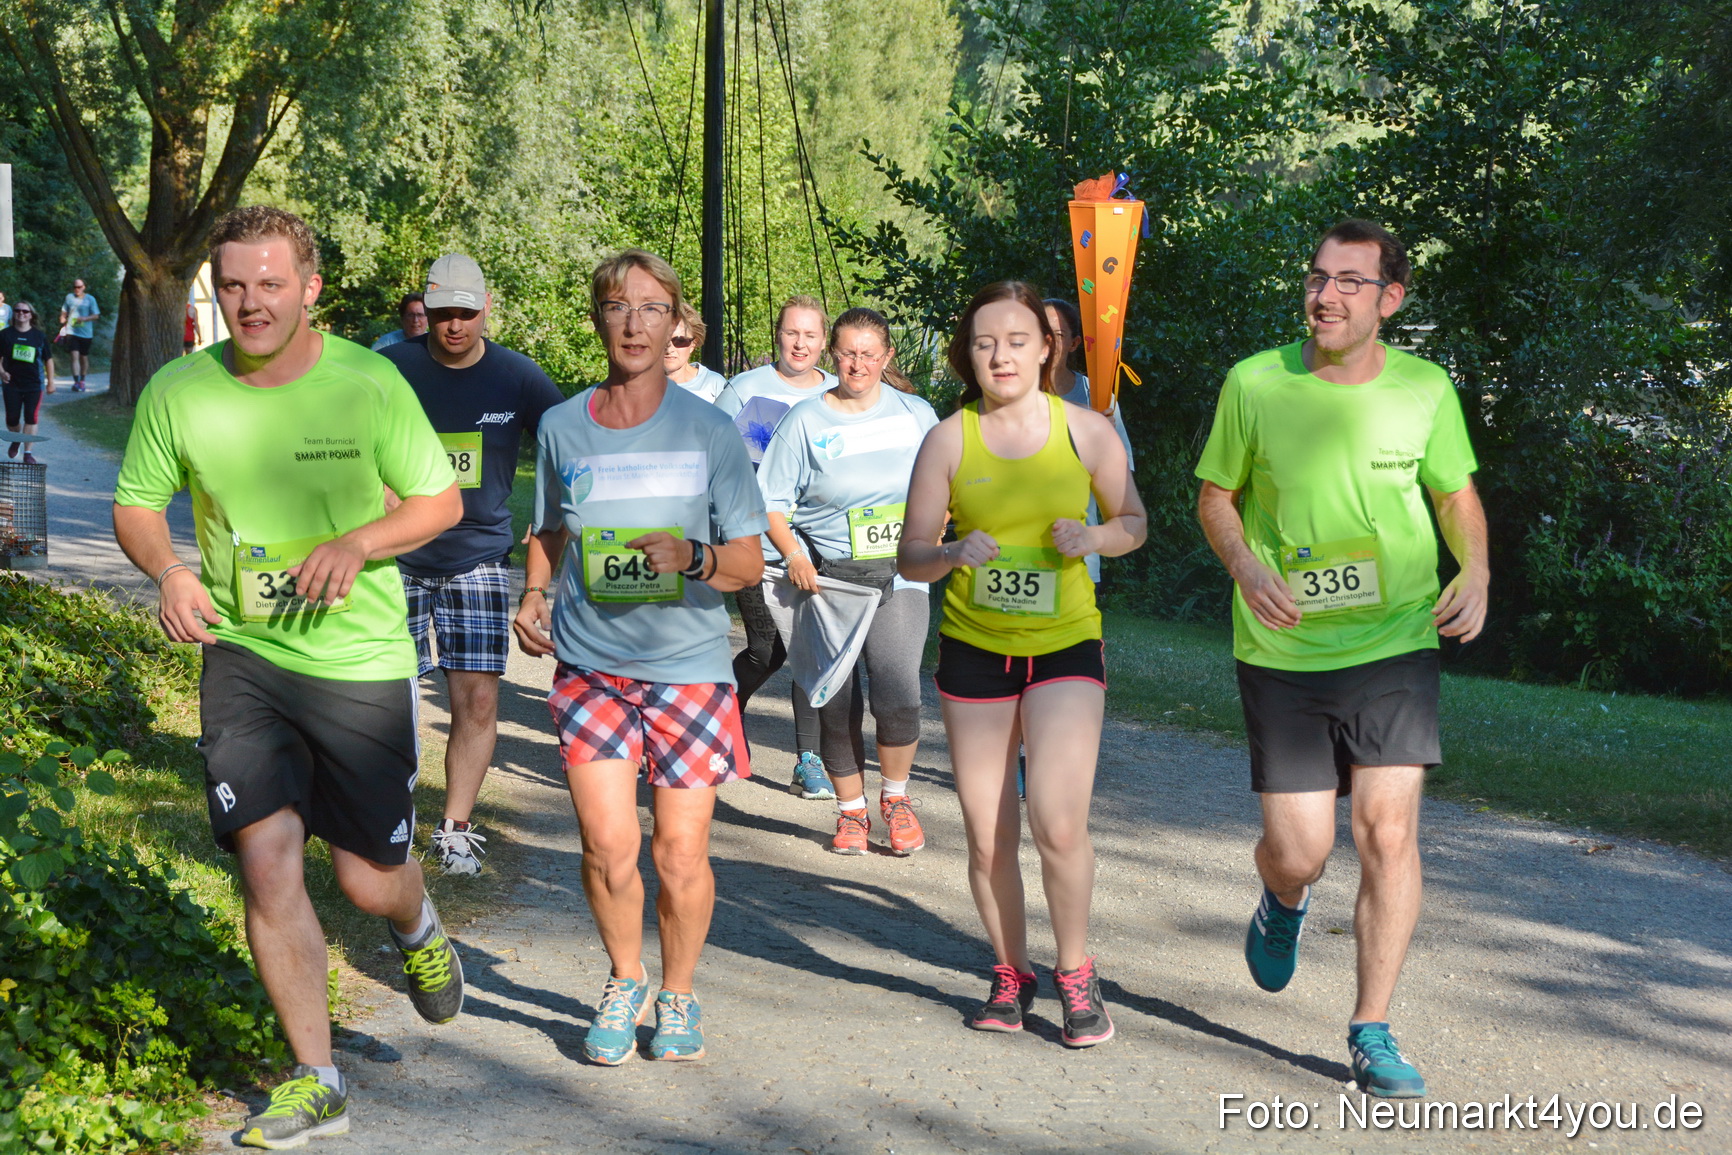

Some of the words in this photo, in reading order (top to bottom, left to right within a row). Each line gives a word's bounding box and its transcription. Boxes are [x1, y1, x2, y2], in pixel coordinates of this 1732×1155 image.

[295, 450, 327, 462] SMART
[329, 449, 361, 460] POWER
[1379, 447, 1395, 456] Team
[598, 466, 616, 474] Freie
[618, 463, 658, 473] katholische
[1371, 461, 1396, 471] SMART
[866, 522, 903, 544] 642
[604, 554, 660, 582] 649
[256, 571, 304, 600] 33
[606, 582, 638, 590] Piszczor
[986, 568, 1040, 598] 335
[1302, 565, 1360, 597] 336
[988, 594, 1010, 604] Fuchs
[1011, 597, 1037, 606] Nadine
[1330, 591, 1376, 603] Christopher
[255, 599, 289, 610] Dietrich
[216, 782, 236, 813] 19
[390, 833, 409, 844] adidas
